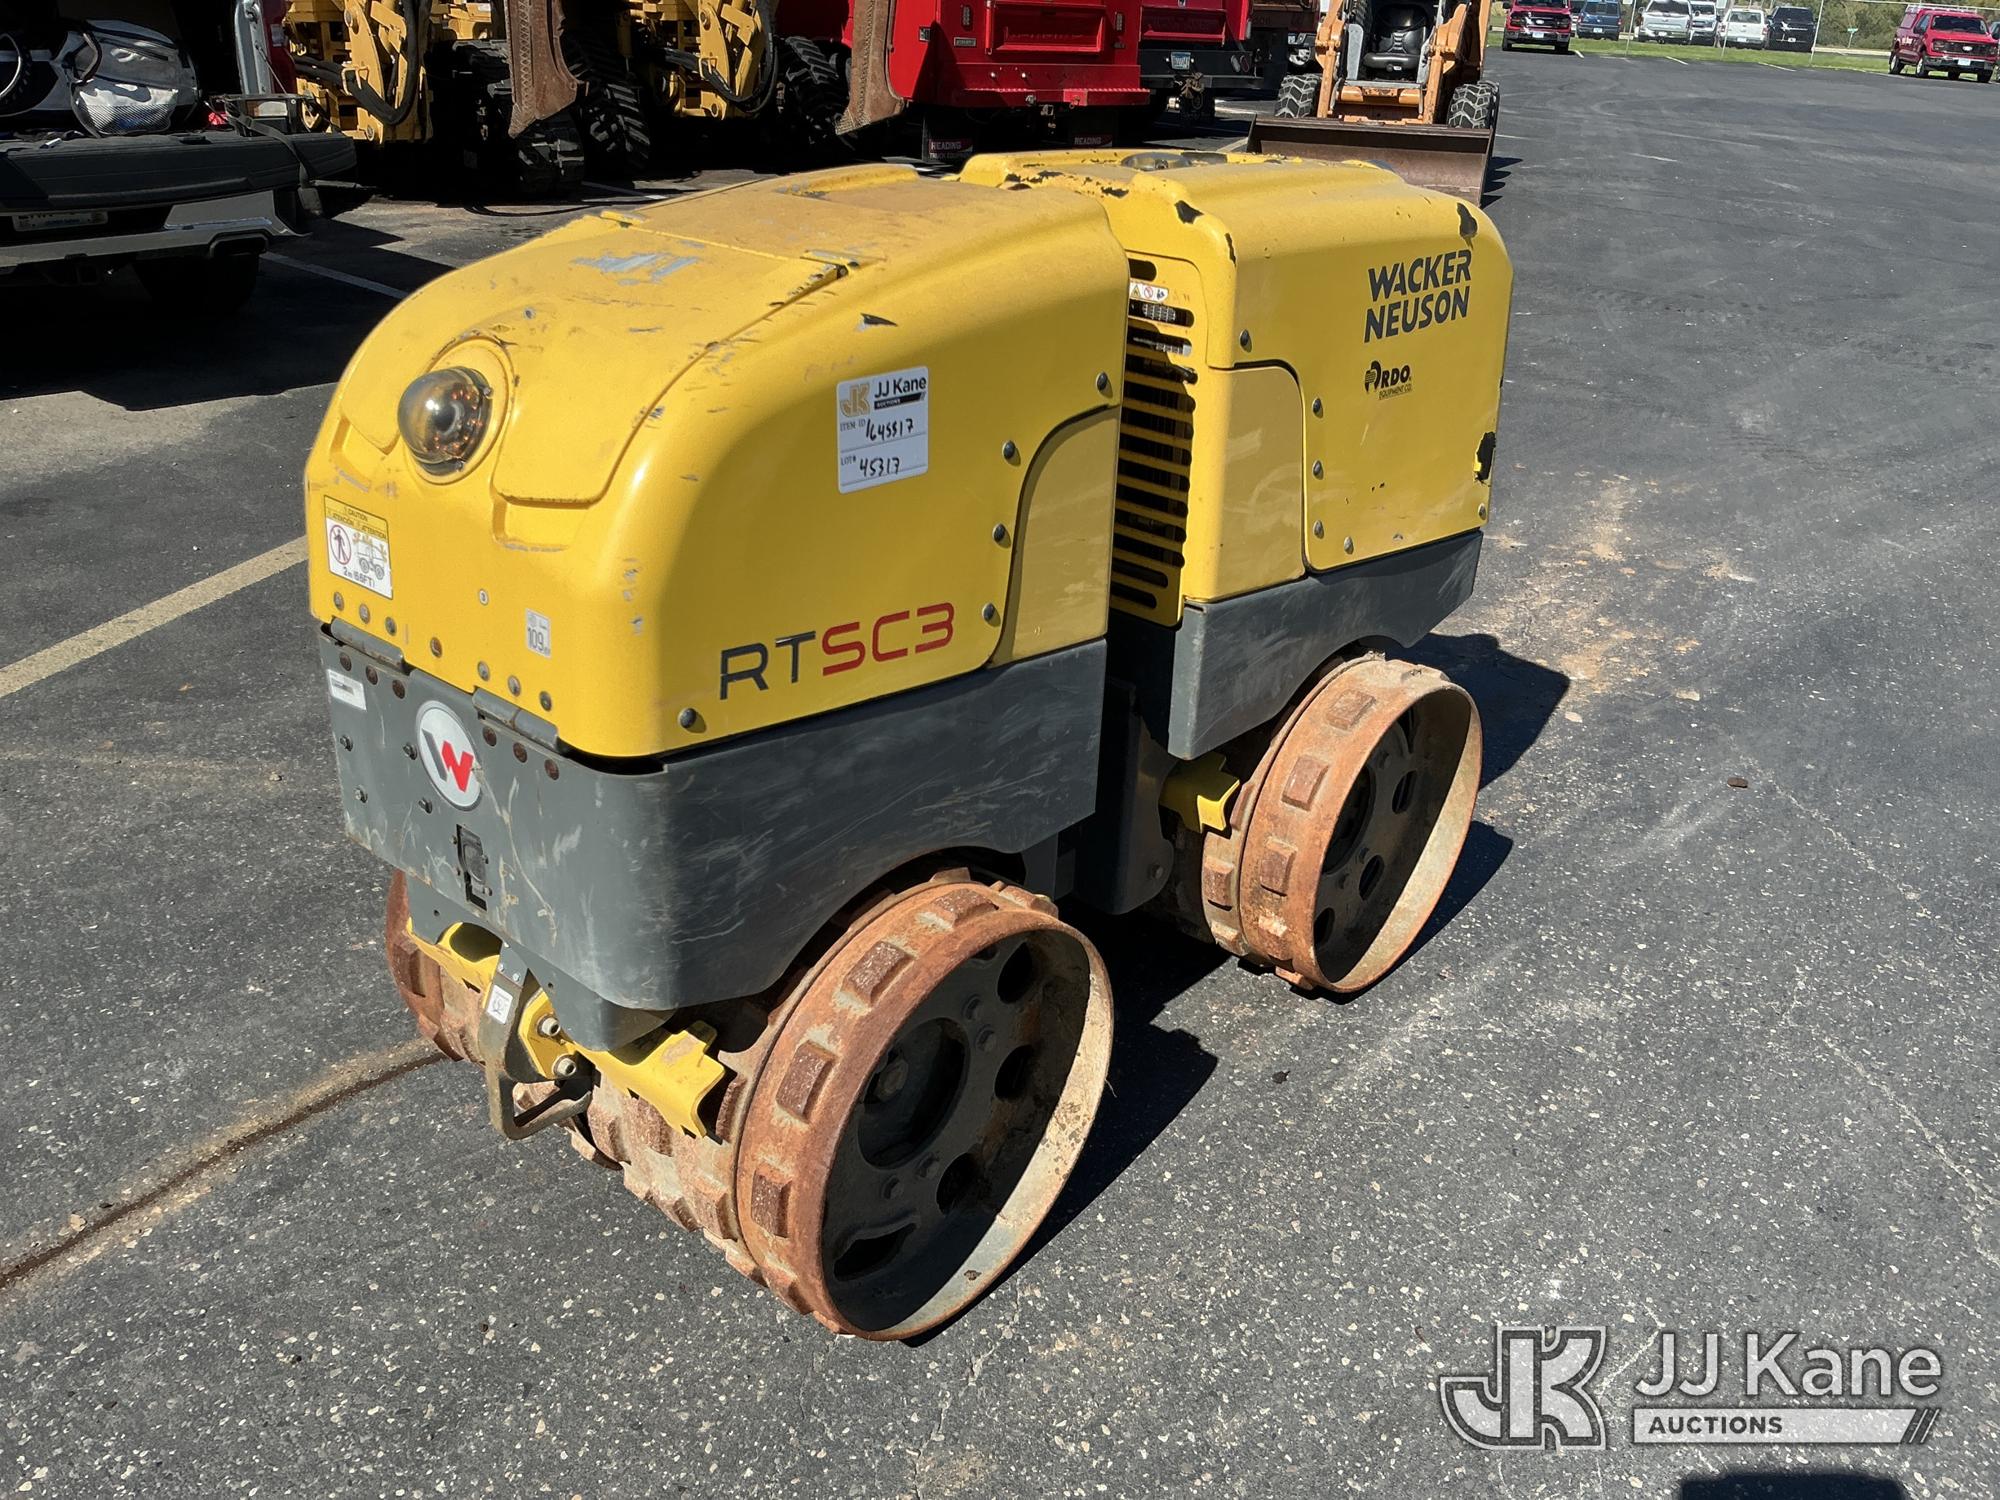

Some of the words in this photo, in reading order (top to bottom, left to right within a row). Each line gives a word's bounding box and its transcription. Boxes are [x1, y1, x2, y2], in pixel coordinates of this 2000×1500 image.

[930, 141, 962, 150] READING
[1074, 136, 1102, 145] READING
[1368, 249, 1472, 302] WACKER
[1364, 286, 1470, 343] NEUSON
[874, 380, 890, 399] JJ
[893, 376, 927, 395] Kane
[876, 398, 901, 409] AUCTIONS
[840, 420, 856, 432] ITEM
[858, 418, 867, 428] ID
[866, 417, 914, 441] 1645517
[860, 456, 900, 477] 45317
[347, 509, 369, 522] CAUTION
[527, 627, 545, 652] 109
